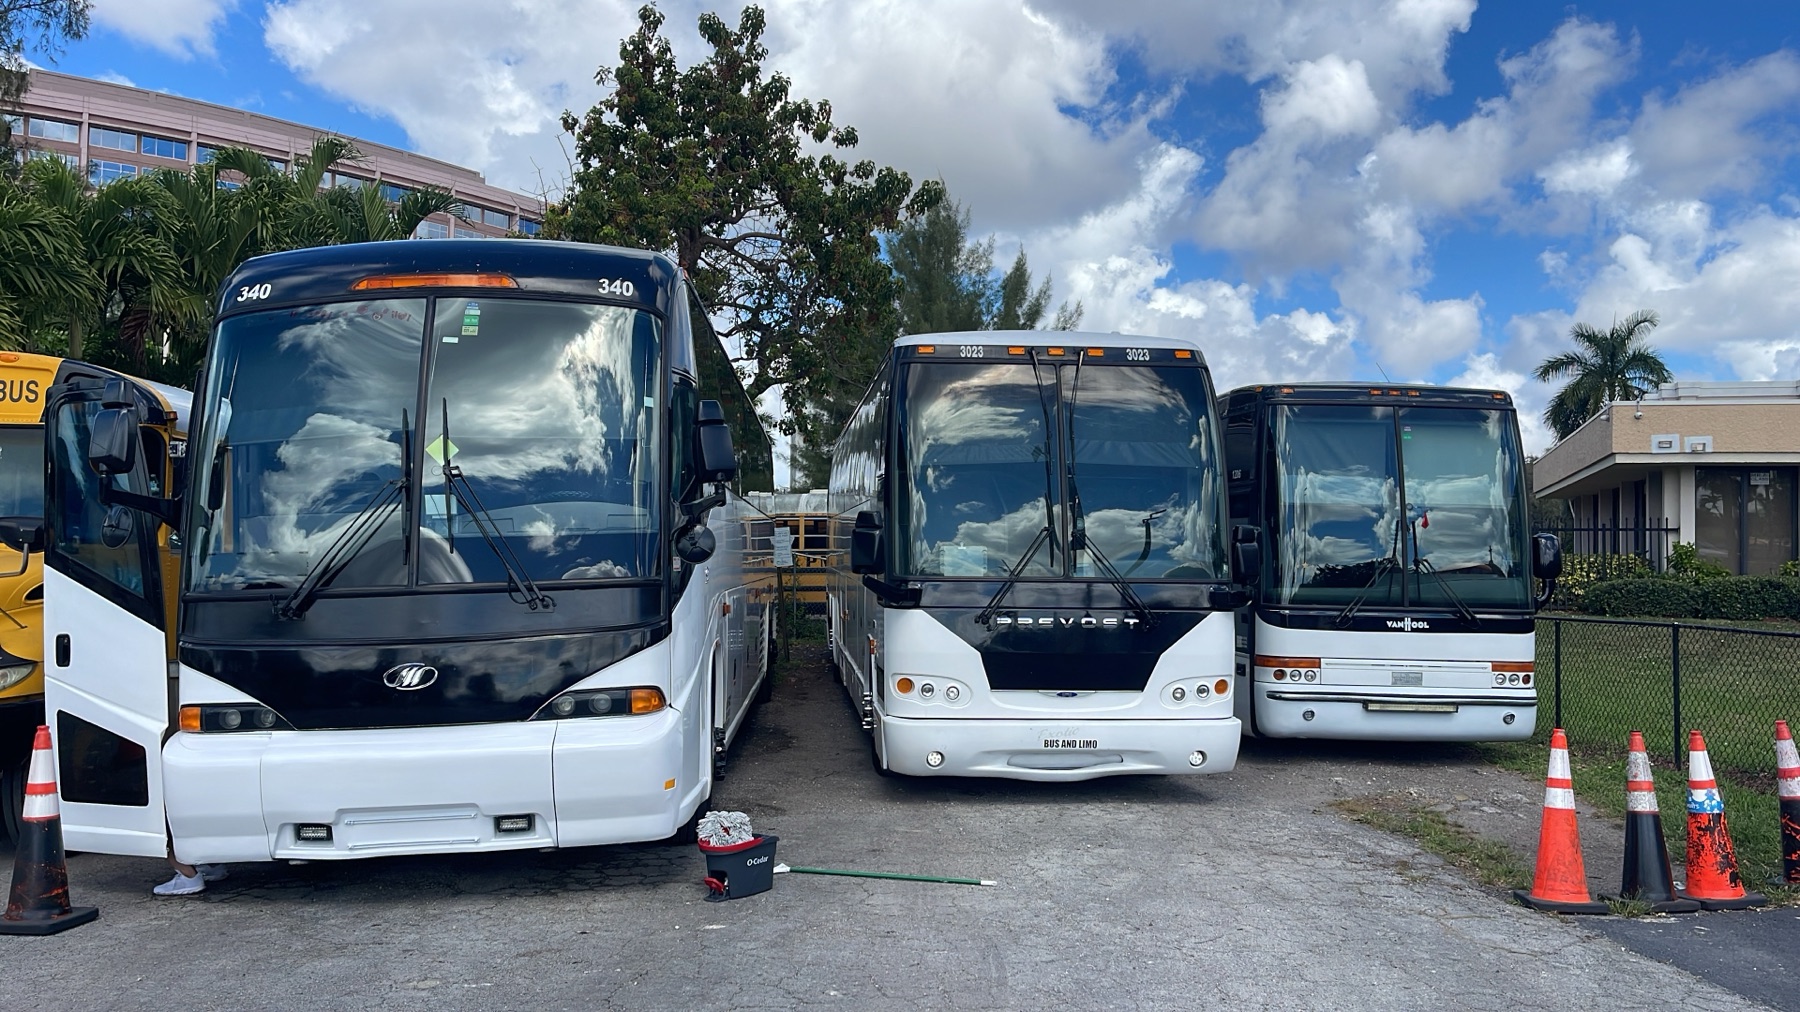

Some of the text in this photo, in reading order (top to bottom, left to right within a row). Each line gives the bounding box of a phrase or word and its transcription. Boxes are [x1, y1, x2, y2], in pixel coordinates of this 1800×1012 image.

[236, 283, 272, 302] 340
[597, 277, 634, 297] 340
[959, 345, 984, 358] 3023
[1125, 348, 1150, 361] 3023
[996, 617, 1140, 630] PREVOST
[1043, 739, 1098, 749] BUS AND LIMO
